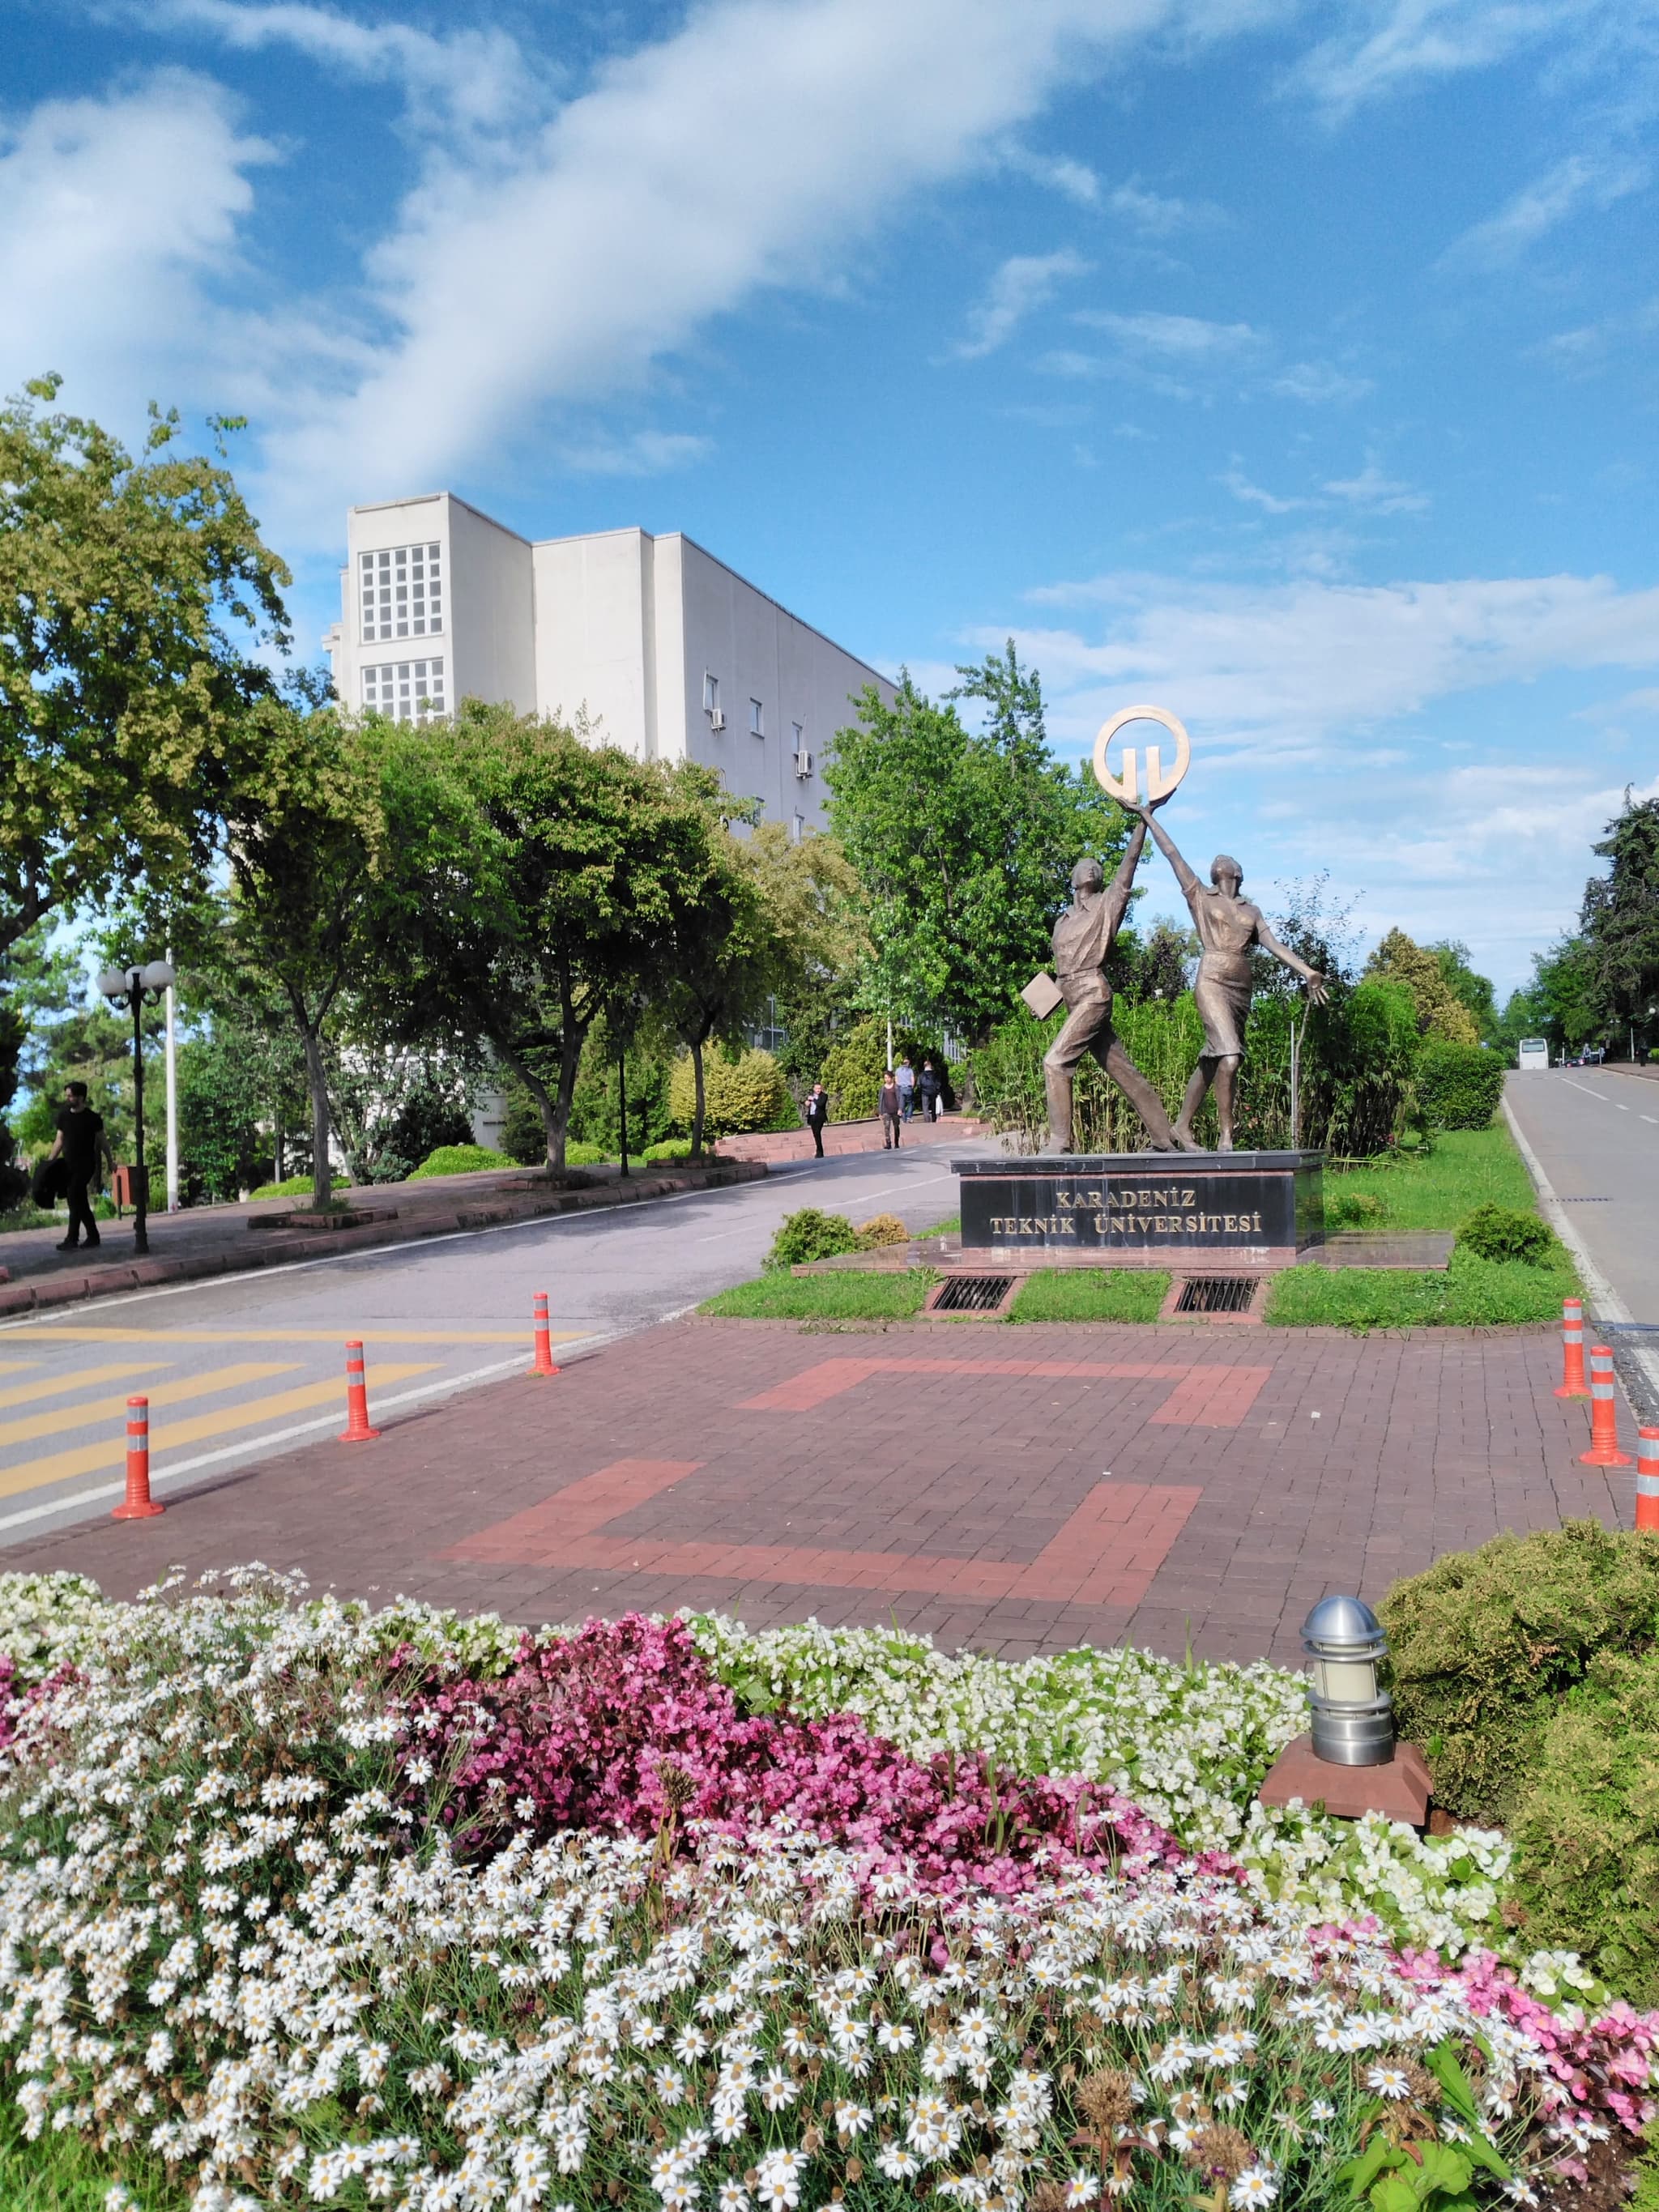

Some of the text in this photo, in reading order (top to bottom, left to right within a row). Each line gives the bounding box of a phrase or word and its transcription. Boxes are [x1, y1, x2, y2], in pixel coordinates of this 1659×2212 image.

[1056, 1186, 1196, 1208] KARADENİZ
[990, 1211, 1263, 1235] TEKNİK ÜNİVERSİTESİ
